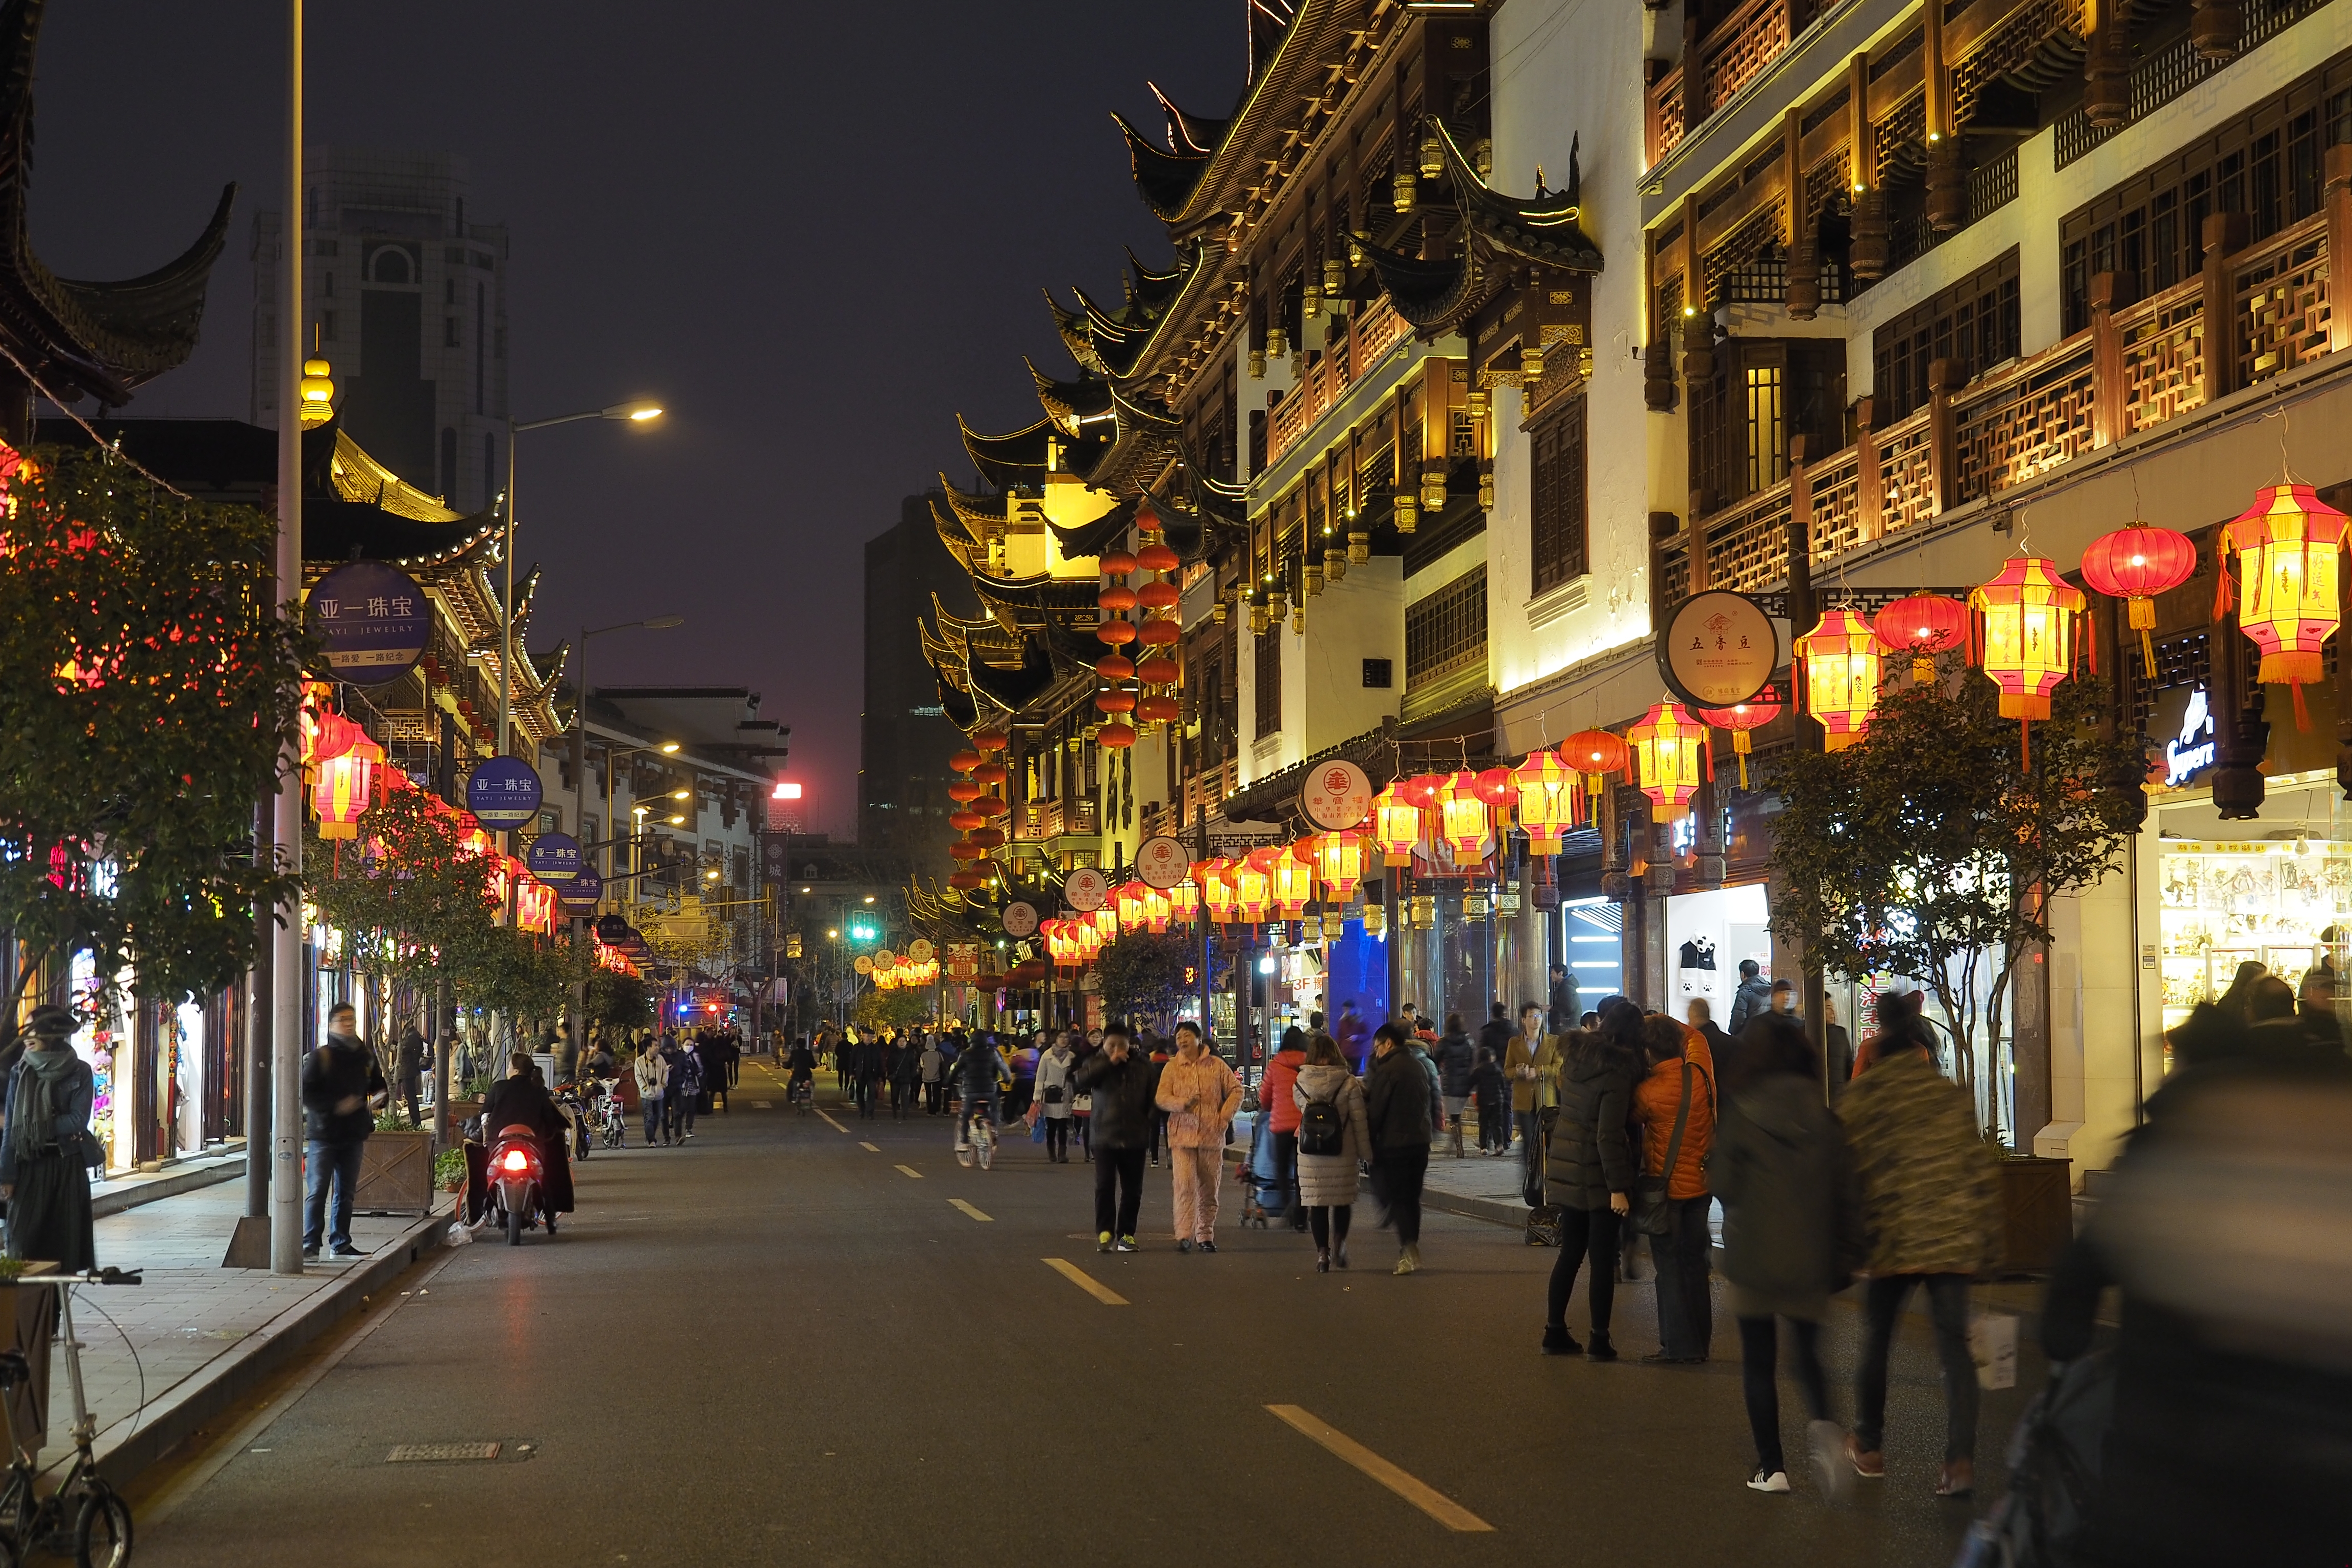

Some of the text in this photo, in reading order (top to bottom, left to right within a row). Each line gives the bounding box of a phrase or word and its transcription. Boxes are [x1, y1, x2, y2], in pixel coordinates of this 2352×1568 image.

[2312, 554, 2325, 608] 好运气
[320, 596, 412, 619] 亚一珠宝
[360, 625, 413, 635] JEWELRY
[1689, 635, 1751, 651] 五香豆
[331, 651, 404, 664] 一路爱 一路纪念
[476, 778, 532, 792] 亚一珠宝
[535, 848, 576, 859] 亚一珠宝
[566, 878, 597, 888] 一珠宝
[1293, 977, 1310, 991] 3F
